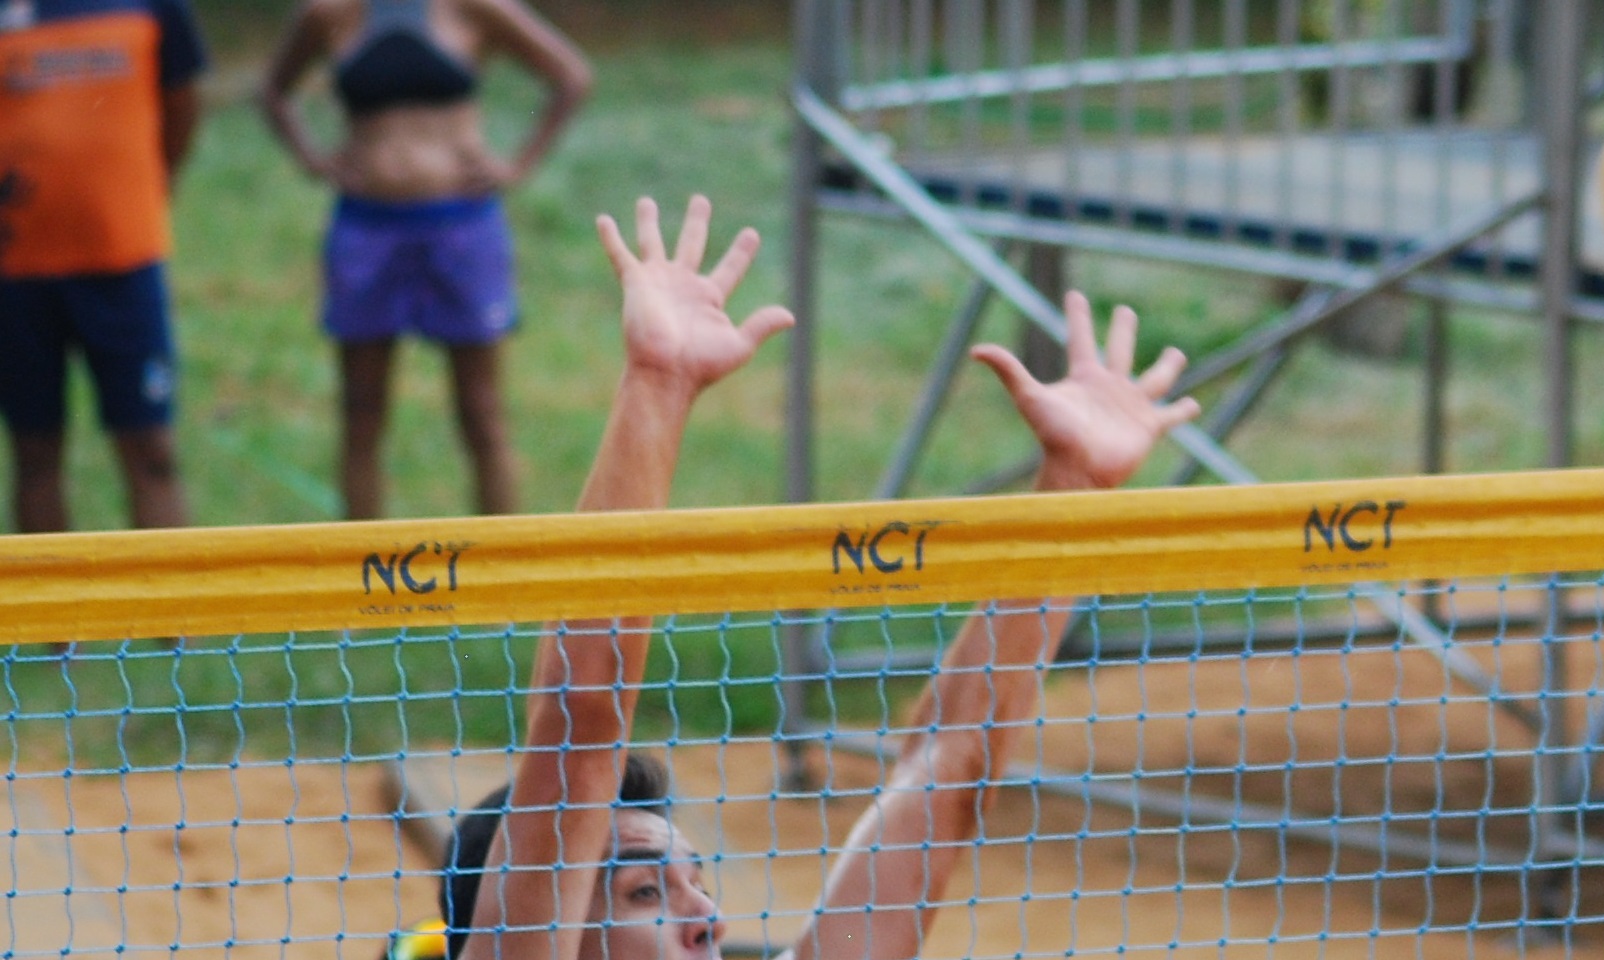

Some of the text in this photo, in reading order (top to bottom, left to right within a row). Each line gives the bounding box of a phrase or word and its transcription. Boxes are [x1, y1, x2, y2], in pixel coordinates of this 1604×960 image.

[832, 520, 946, 574] NCT
[1304, 500, 1405, 552] NCT
[362, 541, 474, 595] NCT
